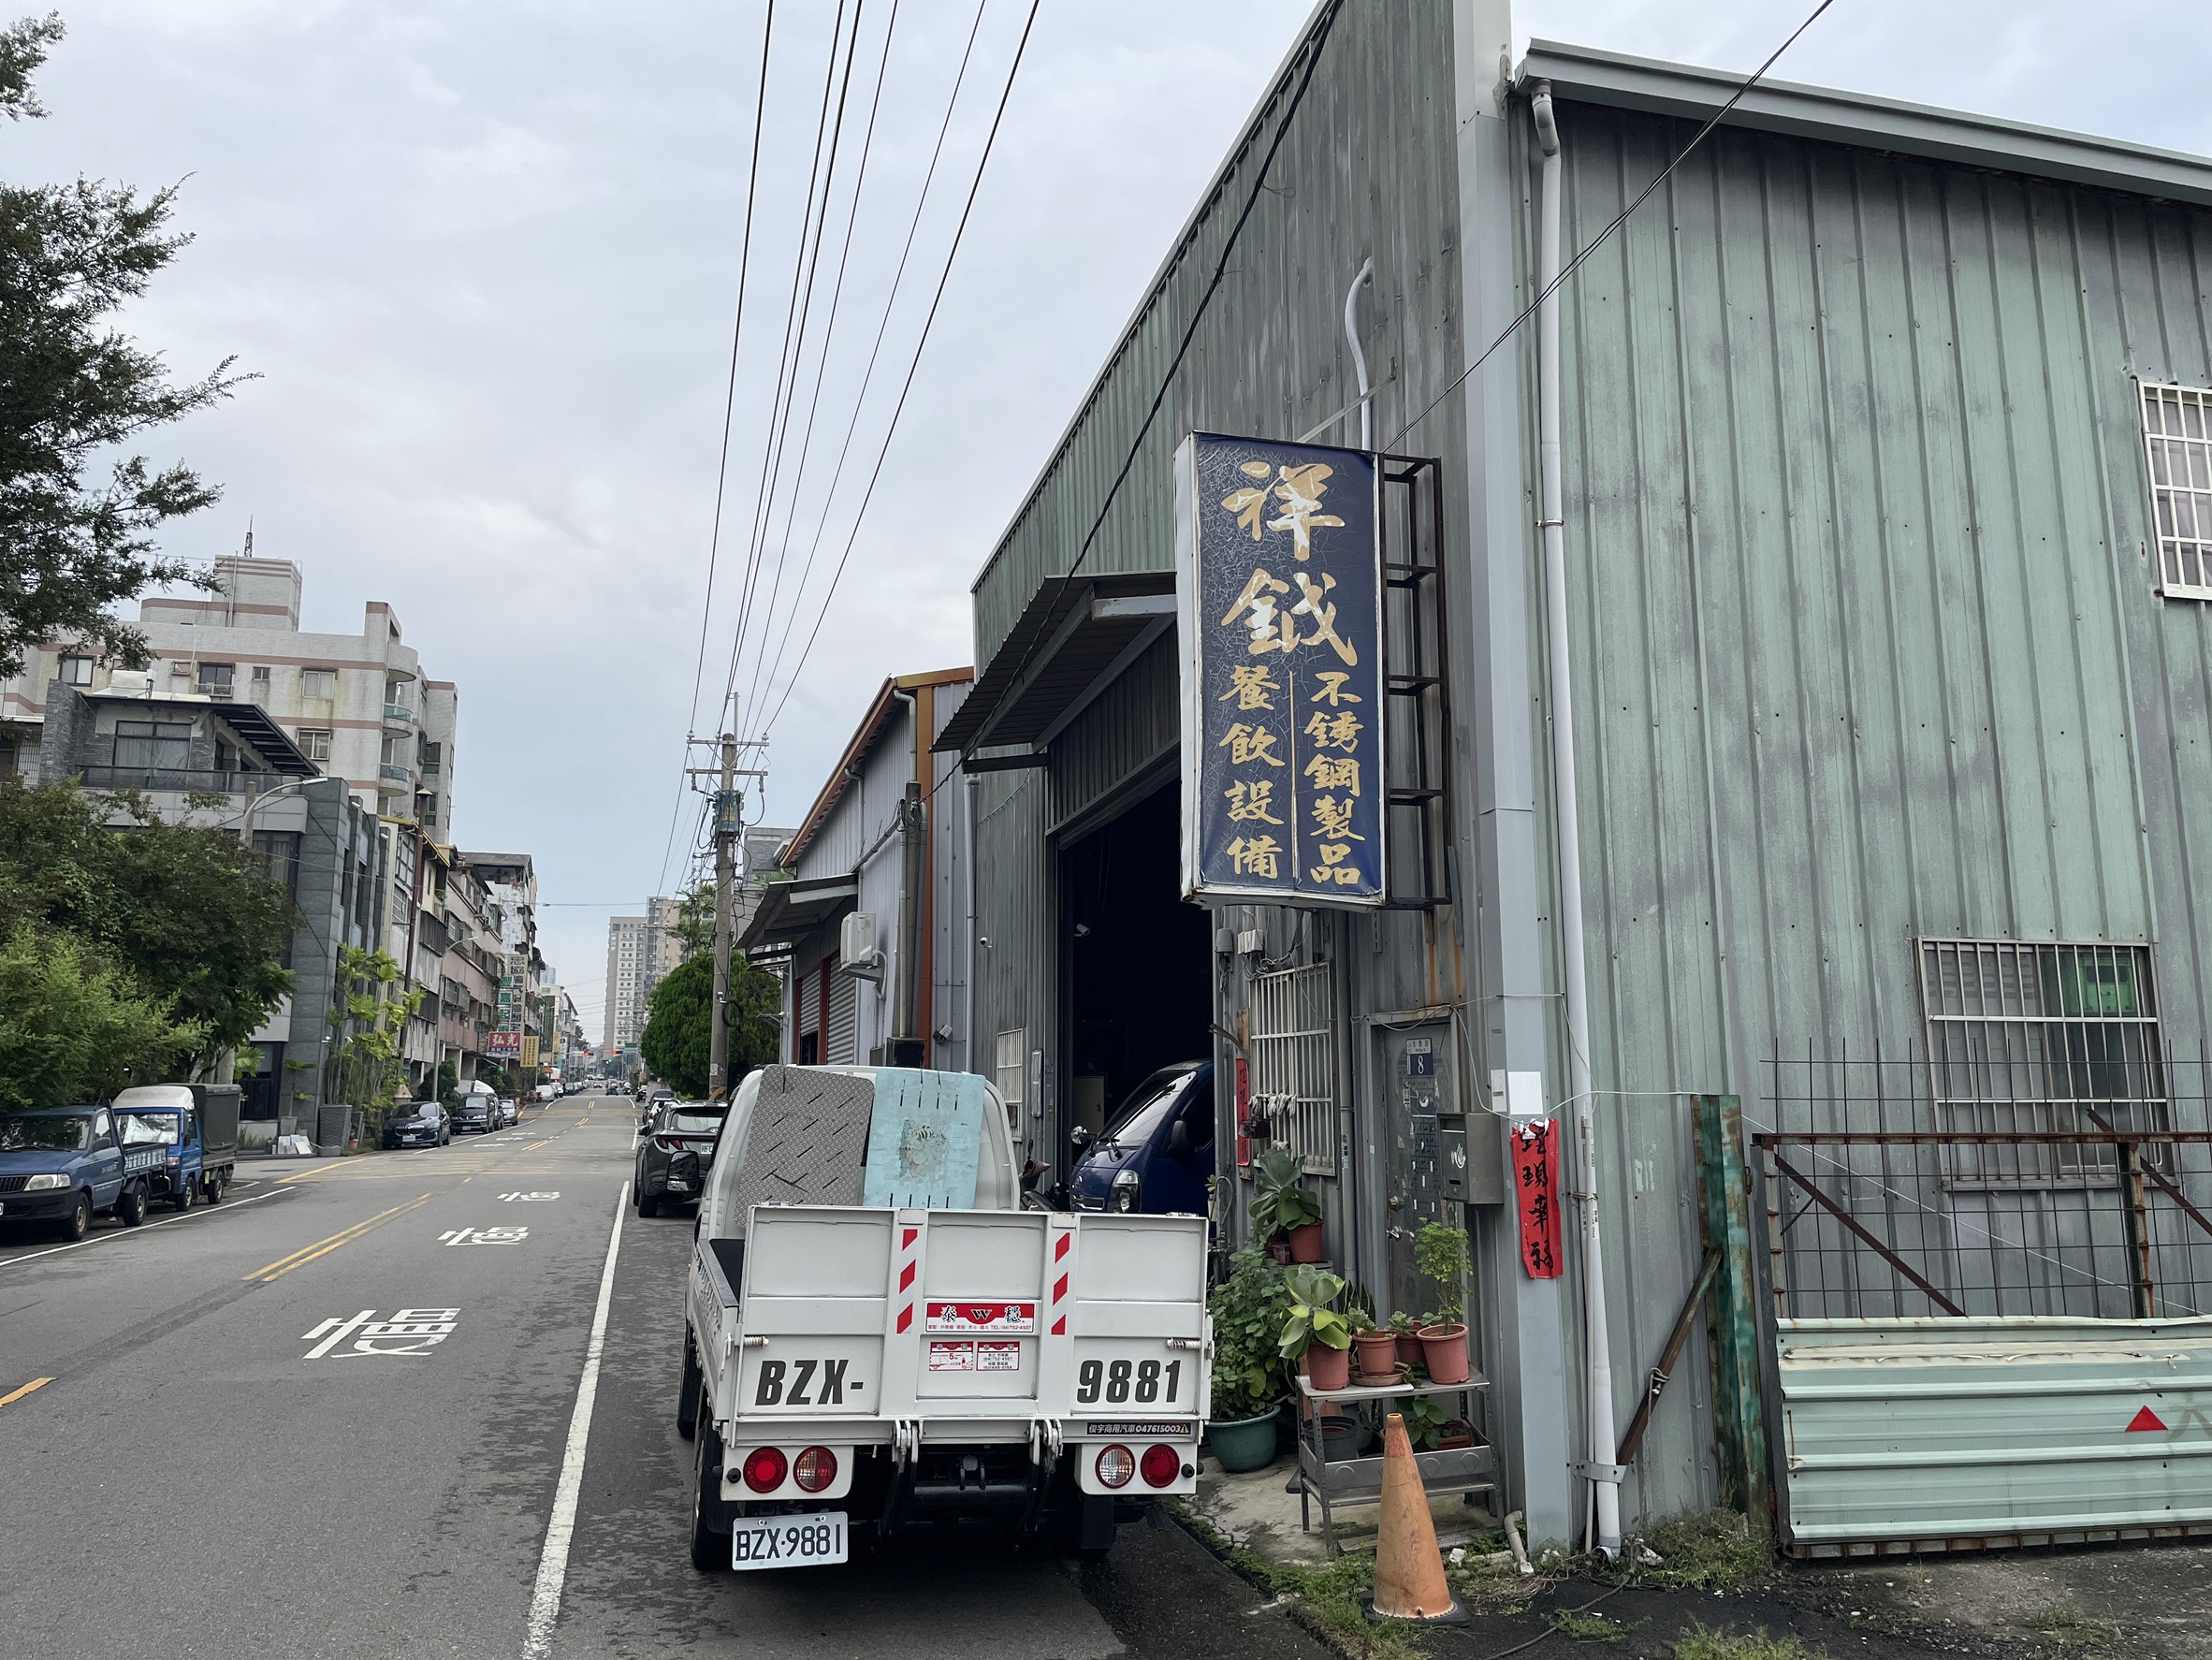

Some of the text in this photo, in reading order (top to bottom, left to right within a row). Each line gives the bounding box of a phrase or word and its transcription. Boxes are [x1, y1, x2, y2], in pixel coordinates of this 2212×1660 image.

[1218, 665, 1286, 880] 餐飲設備
[1303, 671, 1366, 885] 不銹鋼製品
[1418, 1056, 1424, 1074] 8
[497, 1191, 560, 1201] 慢
[437, 1227, 529, 1246] 慢
[300, 1308, 461, 1359] 慢
[755, 1360, 1181, 1405] BZX- 9881
